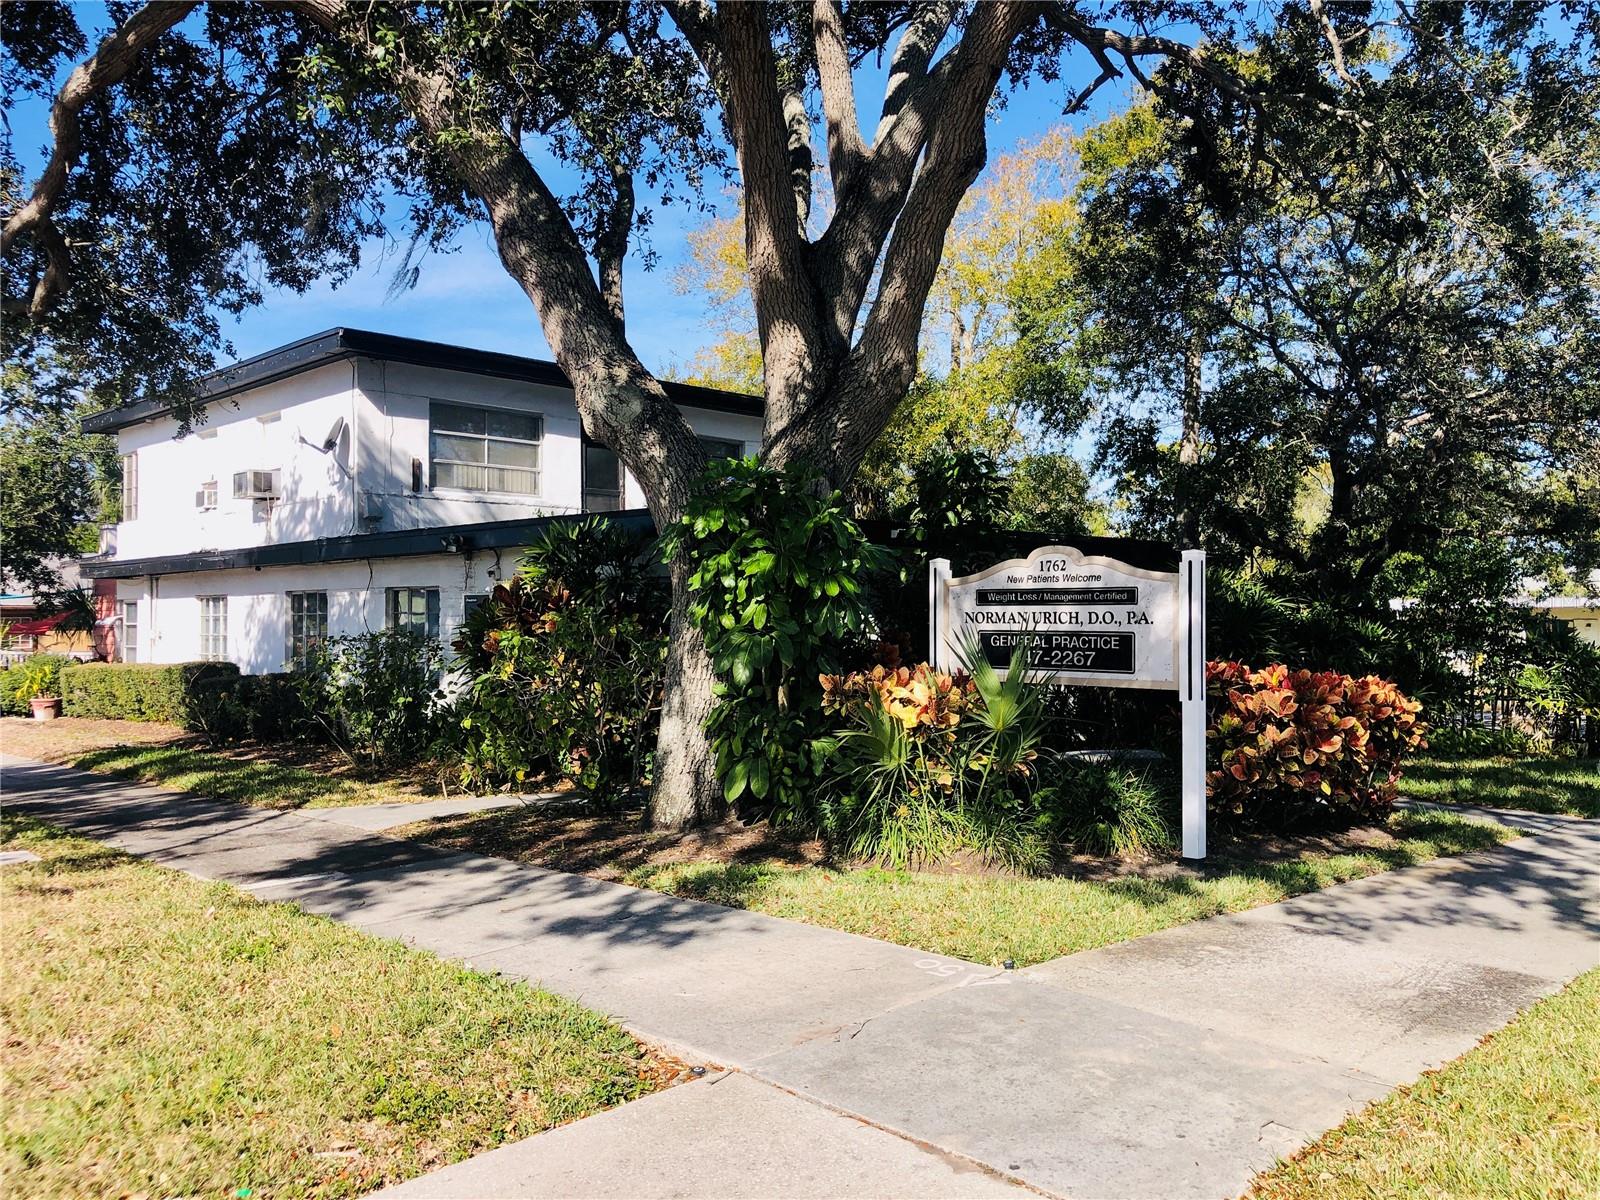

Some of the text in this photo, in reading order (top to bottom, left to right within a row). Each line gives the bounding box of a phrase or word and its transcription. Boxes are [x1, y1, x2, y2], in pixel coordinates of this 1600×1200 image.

[1039, 559, 1066, 572] 1762
[1006, 573, 1102, 584] New Patients Welcome
[987, 592, 1016, 603] Weight
[1017, 592, 1038, 601] Loss
[1043, 591, 1092, 602] Management
[1093, 591, 1127, 600] Certified
[964, 610, 1154, 627] NORMAN URICH, D.O., P.A.
[1052, 635, 1120, 649] PRACTICE
